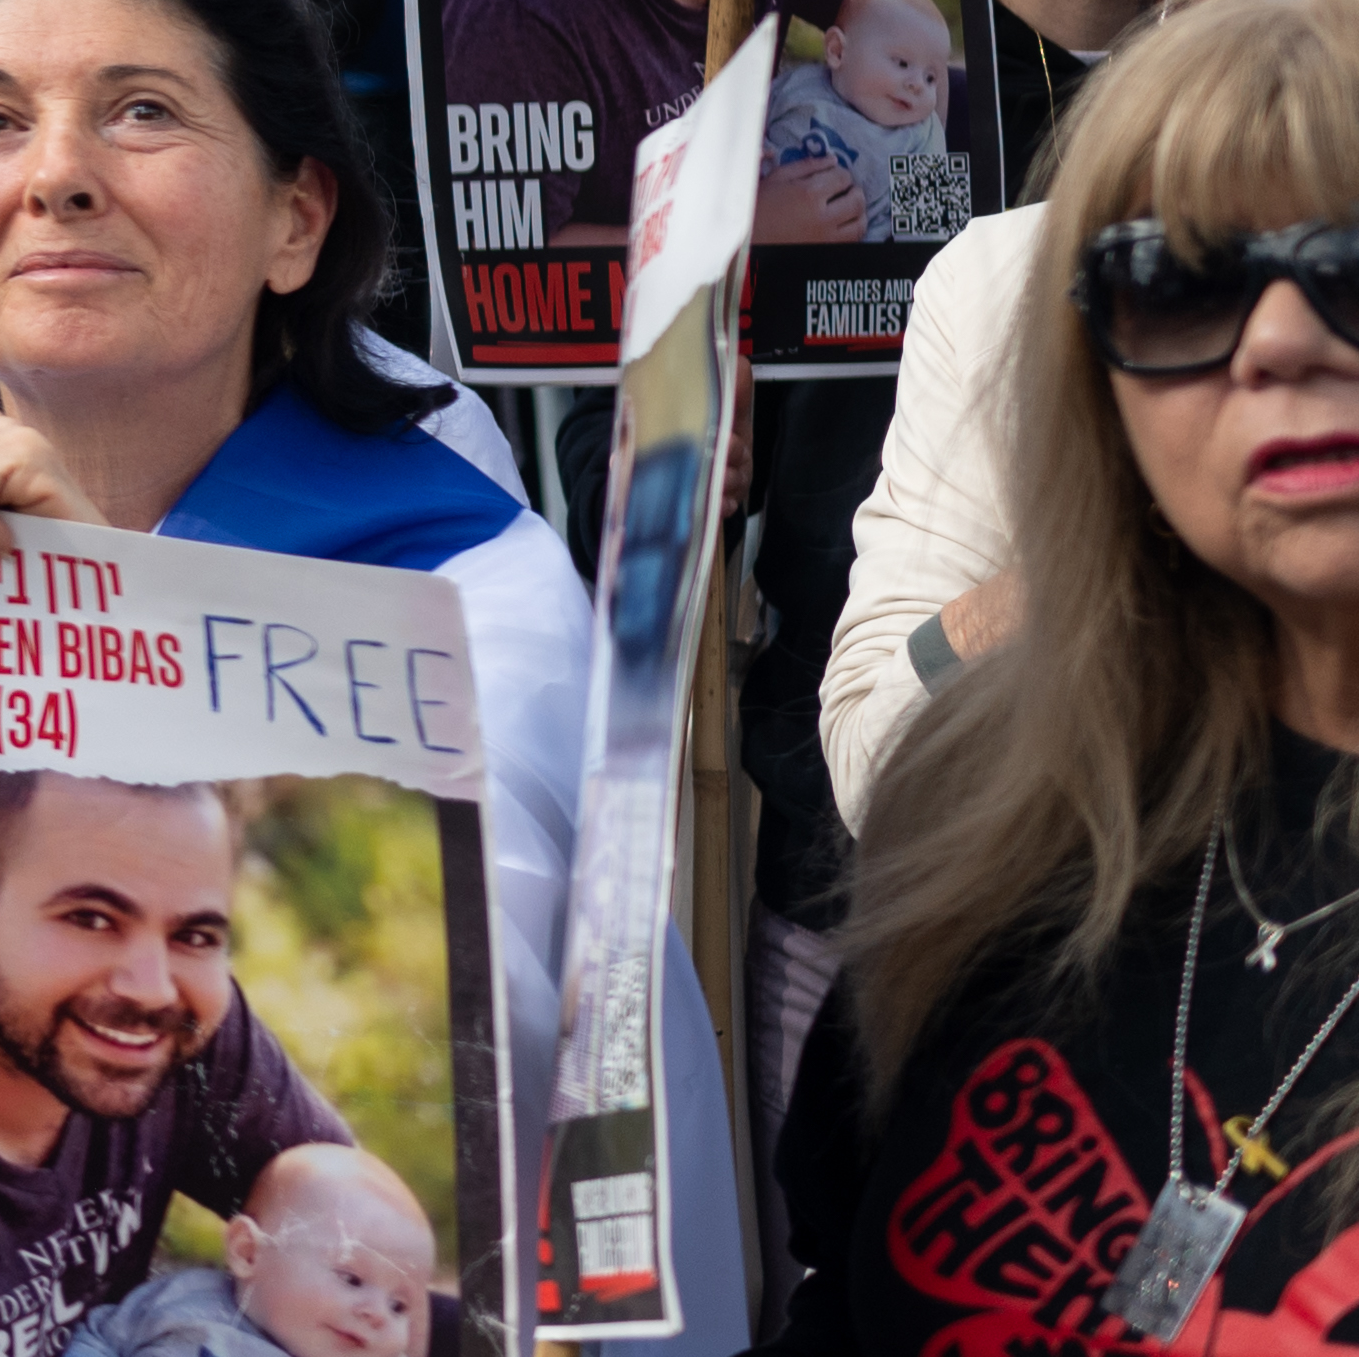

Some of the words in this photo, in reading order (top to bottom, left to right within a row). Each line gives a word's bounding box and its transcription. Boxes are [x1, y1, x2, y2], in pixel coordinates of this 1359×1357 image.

[447, 100, 595, 176] BRING
[451, 179, 544, 251] HIM
[463, 262, 595, 334] HOME
[806, 279, 881, 304] HOSTAGES
[883, 279, 913, 303] AND
[806, 303, 901, 338] FAMILIES
[39, 551, 123, 614] ירדן
[55, 620, 186, 690] BIBAS
[201, 614, 466, 755] FREE
